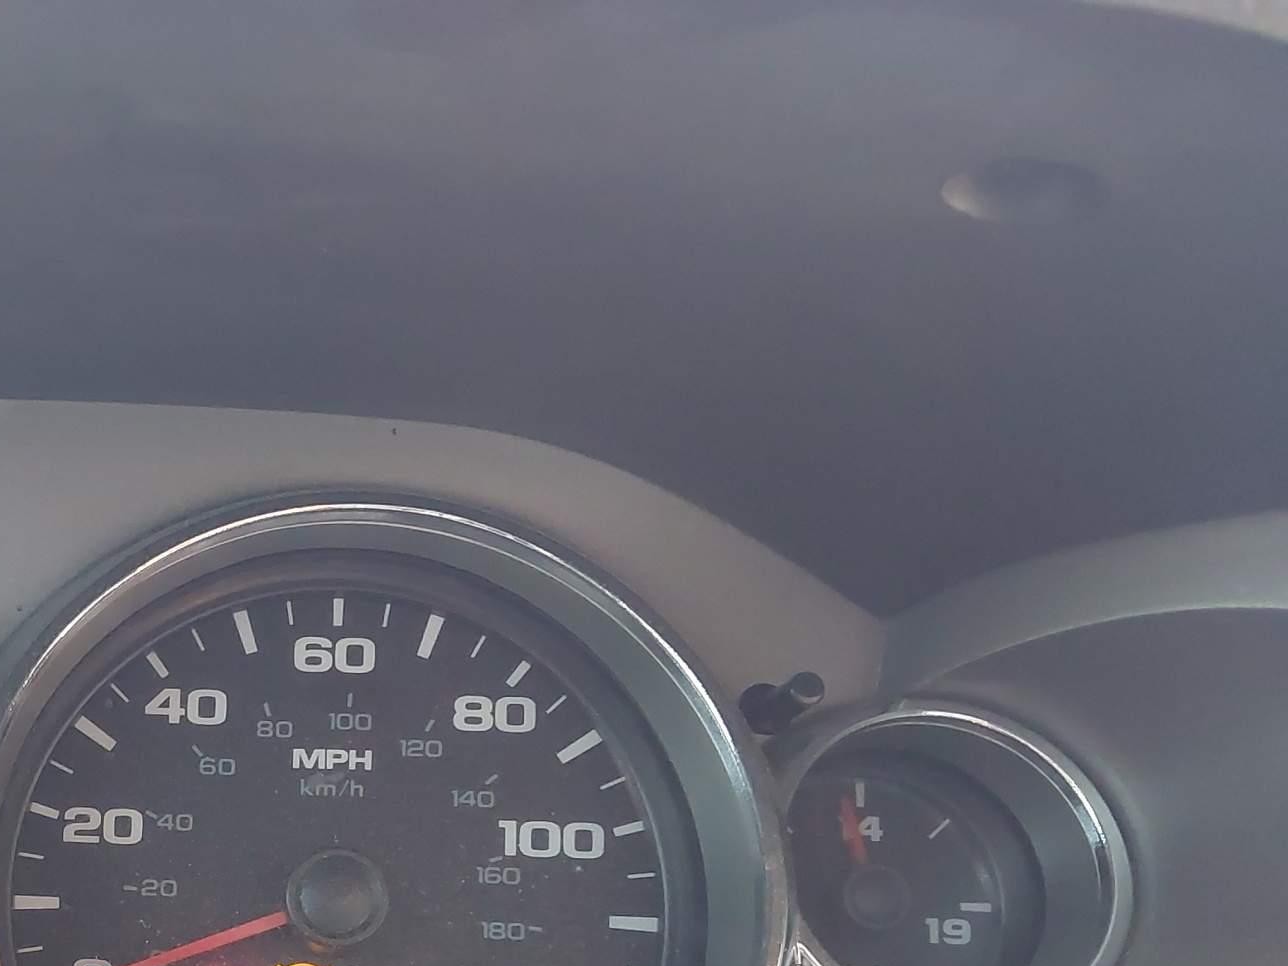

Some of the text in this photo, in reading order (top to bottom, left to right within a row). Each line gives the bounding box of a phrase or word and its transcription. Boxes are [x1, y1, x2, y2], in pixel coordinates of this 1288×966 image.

[293, 636, 376, 674] 60
[144, 688, 227, 725] 40
[452, 695, 536, 733] 80
[256, 720, 293, 738] 80
[328, 712, 372, 731] 100
[400, 739, 442, 758] 120
[199, 757, 235, 776] 60
[291, 748, 373, 770] MPH
[299, 779, 365, 798] km/h
[452, 790, 495, 809] 140
[62, 807, 143, 845] 20
[156, 813, 193, 831] 40
[498, 819, 605, 859] 100
[476, 867, 520, 885] 160
[140, 879, 177, 897] 20
[481, 921, 526, 941] 180
[925, 918, 972, 945] 19
